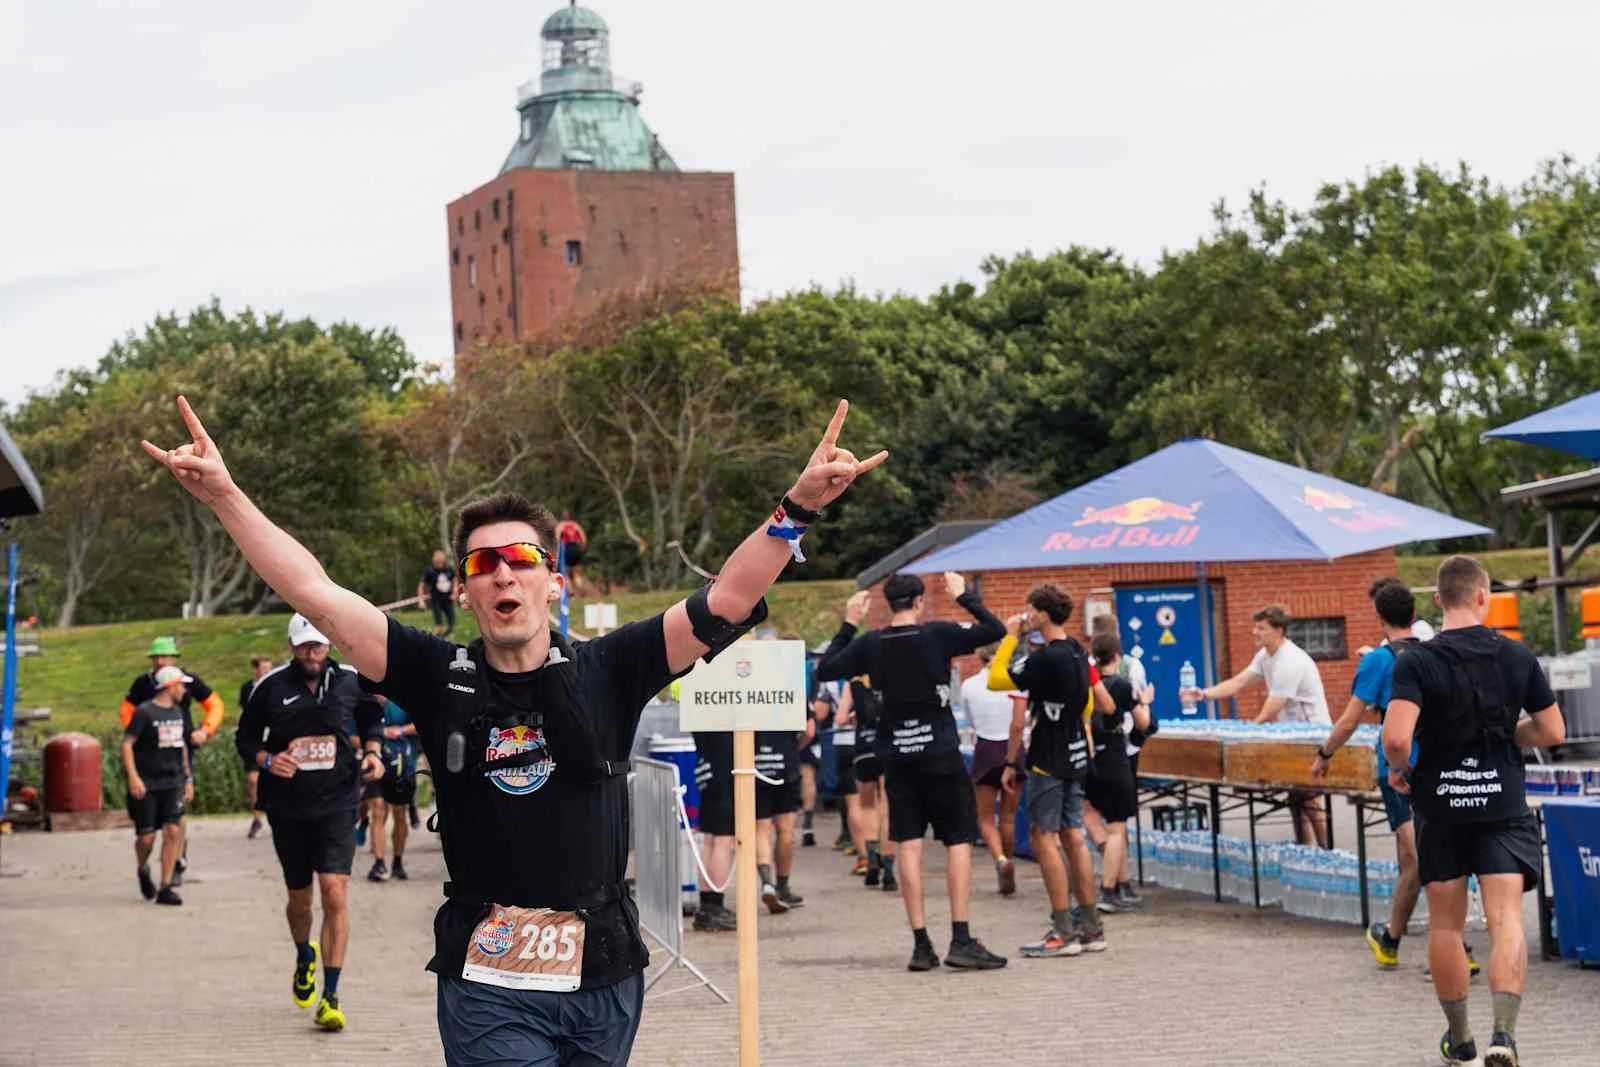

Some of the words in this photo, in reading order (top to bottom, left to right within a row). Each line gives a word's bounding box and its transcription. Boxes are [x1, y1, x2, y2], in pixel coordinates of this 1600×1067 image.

[1041, 527, 1120, 552] Red
[1119, 525, 1201, 547] Bull
[694, 691, 743, 705] RECHTS
[747, 690, 794, 705] HALTEN
[309, 742, 335, 759] 550
[1449, 797, 1488, 808] IONITY
[518, 923, 577, 961] 285
